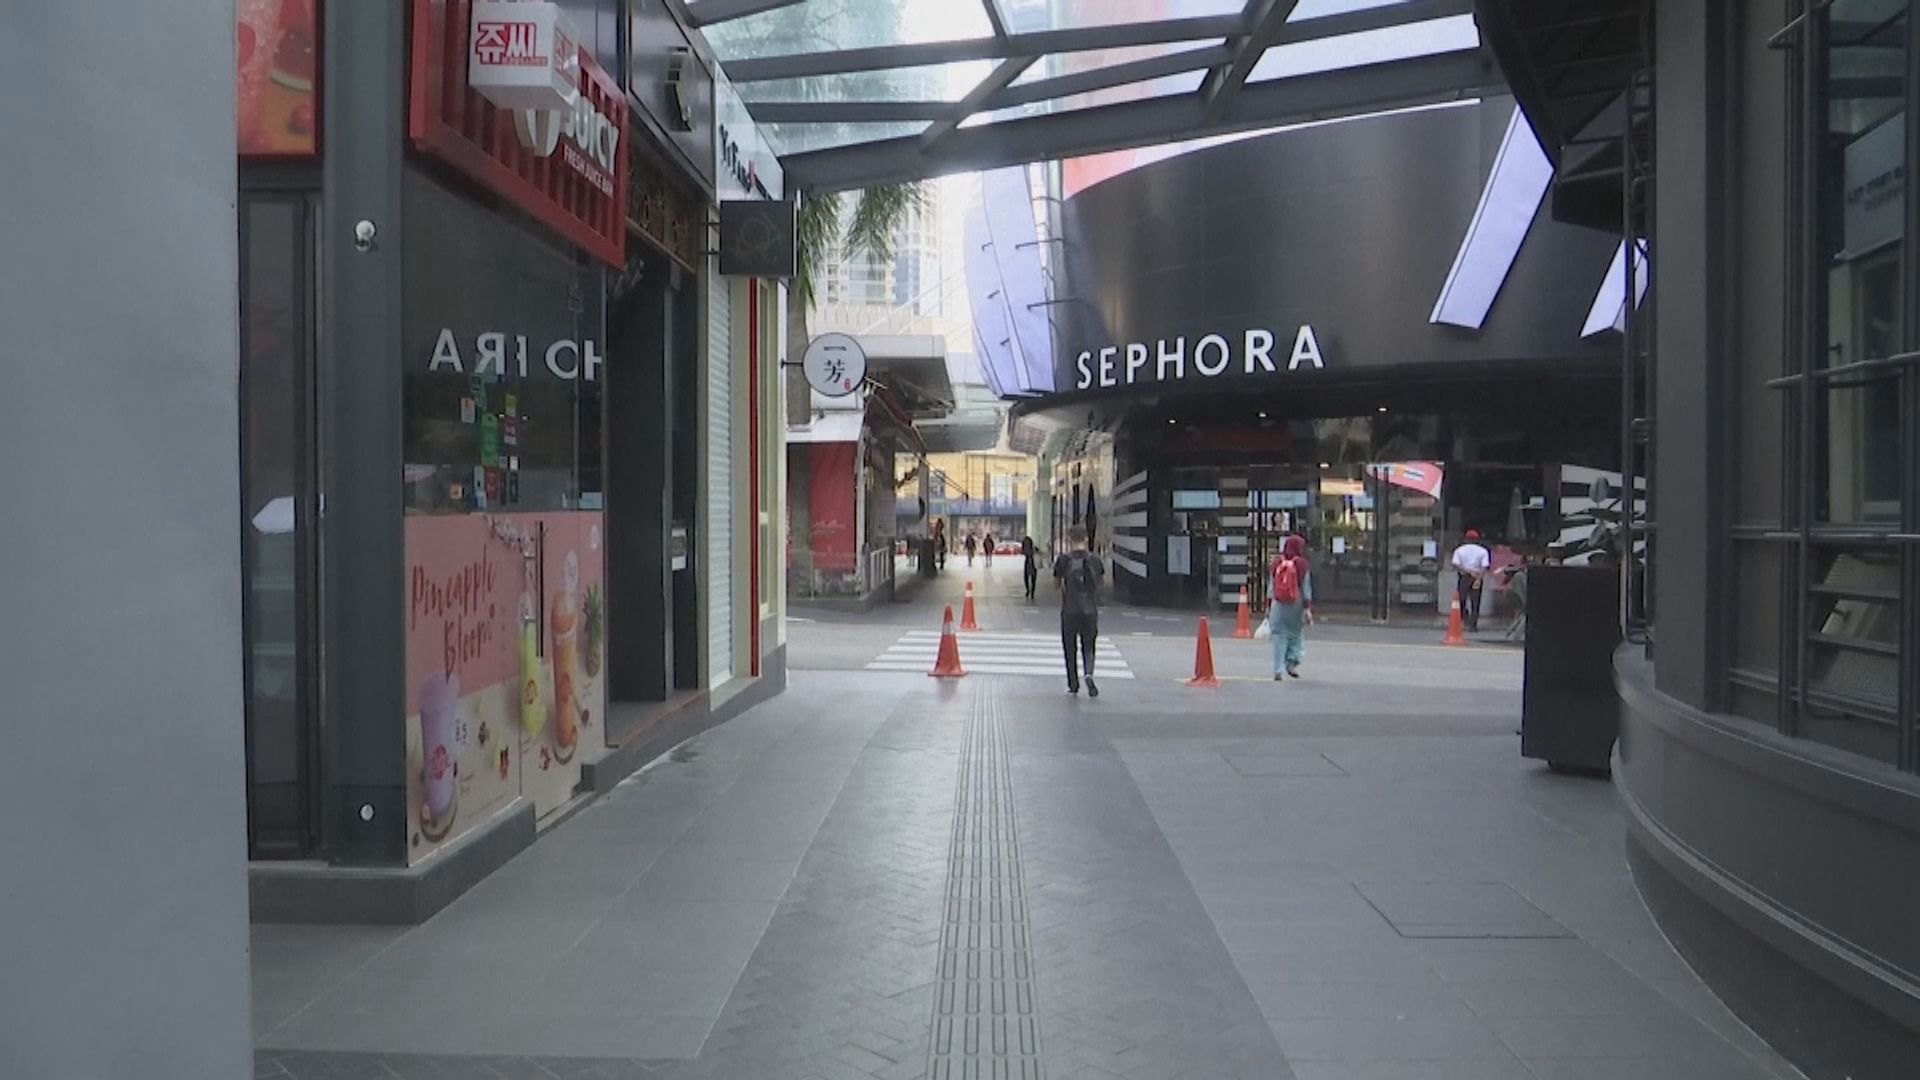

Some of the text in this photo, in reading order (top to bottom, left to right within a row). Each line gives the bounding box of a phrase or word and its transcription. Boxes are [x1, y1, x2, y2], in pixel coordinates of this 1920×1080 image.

[475, 22, 537, 65] 쥬씨
[823, 344, 848, 385] 一芳
[1076, 324, 1326, 390] SEPHORA
[412, 543, 496, 632] Pineapple
